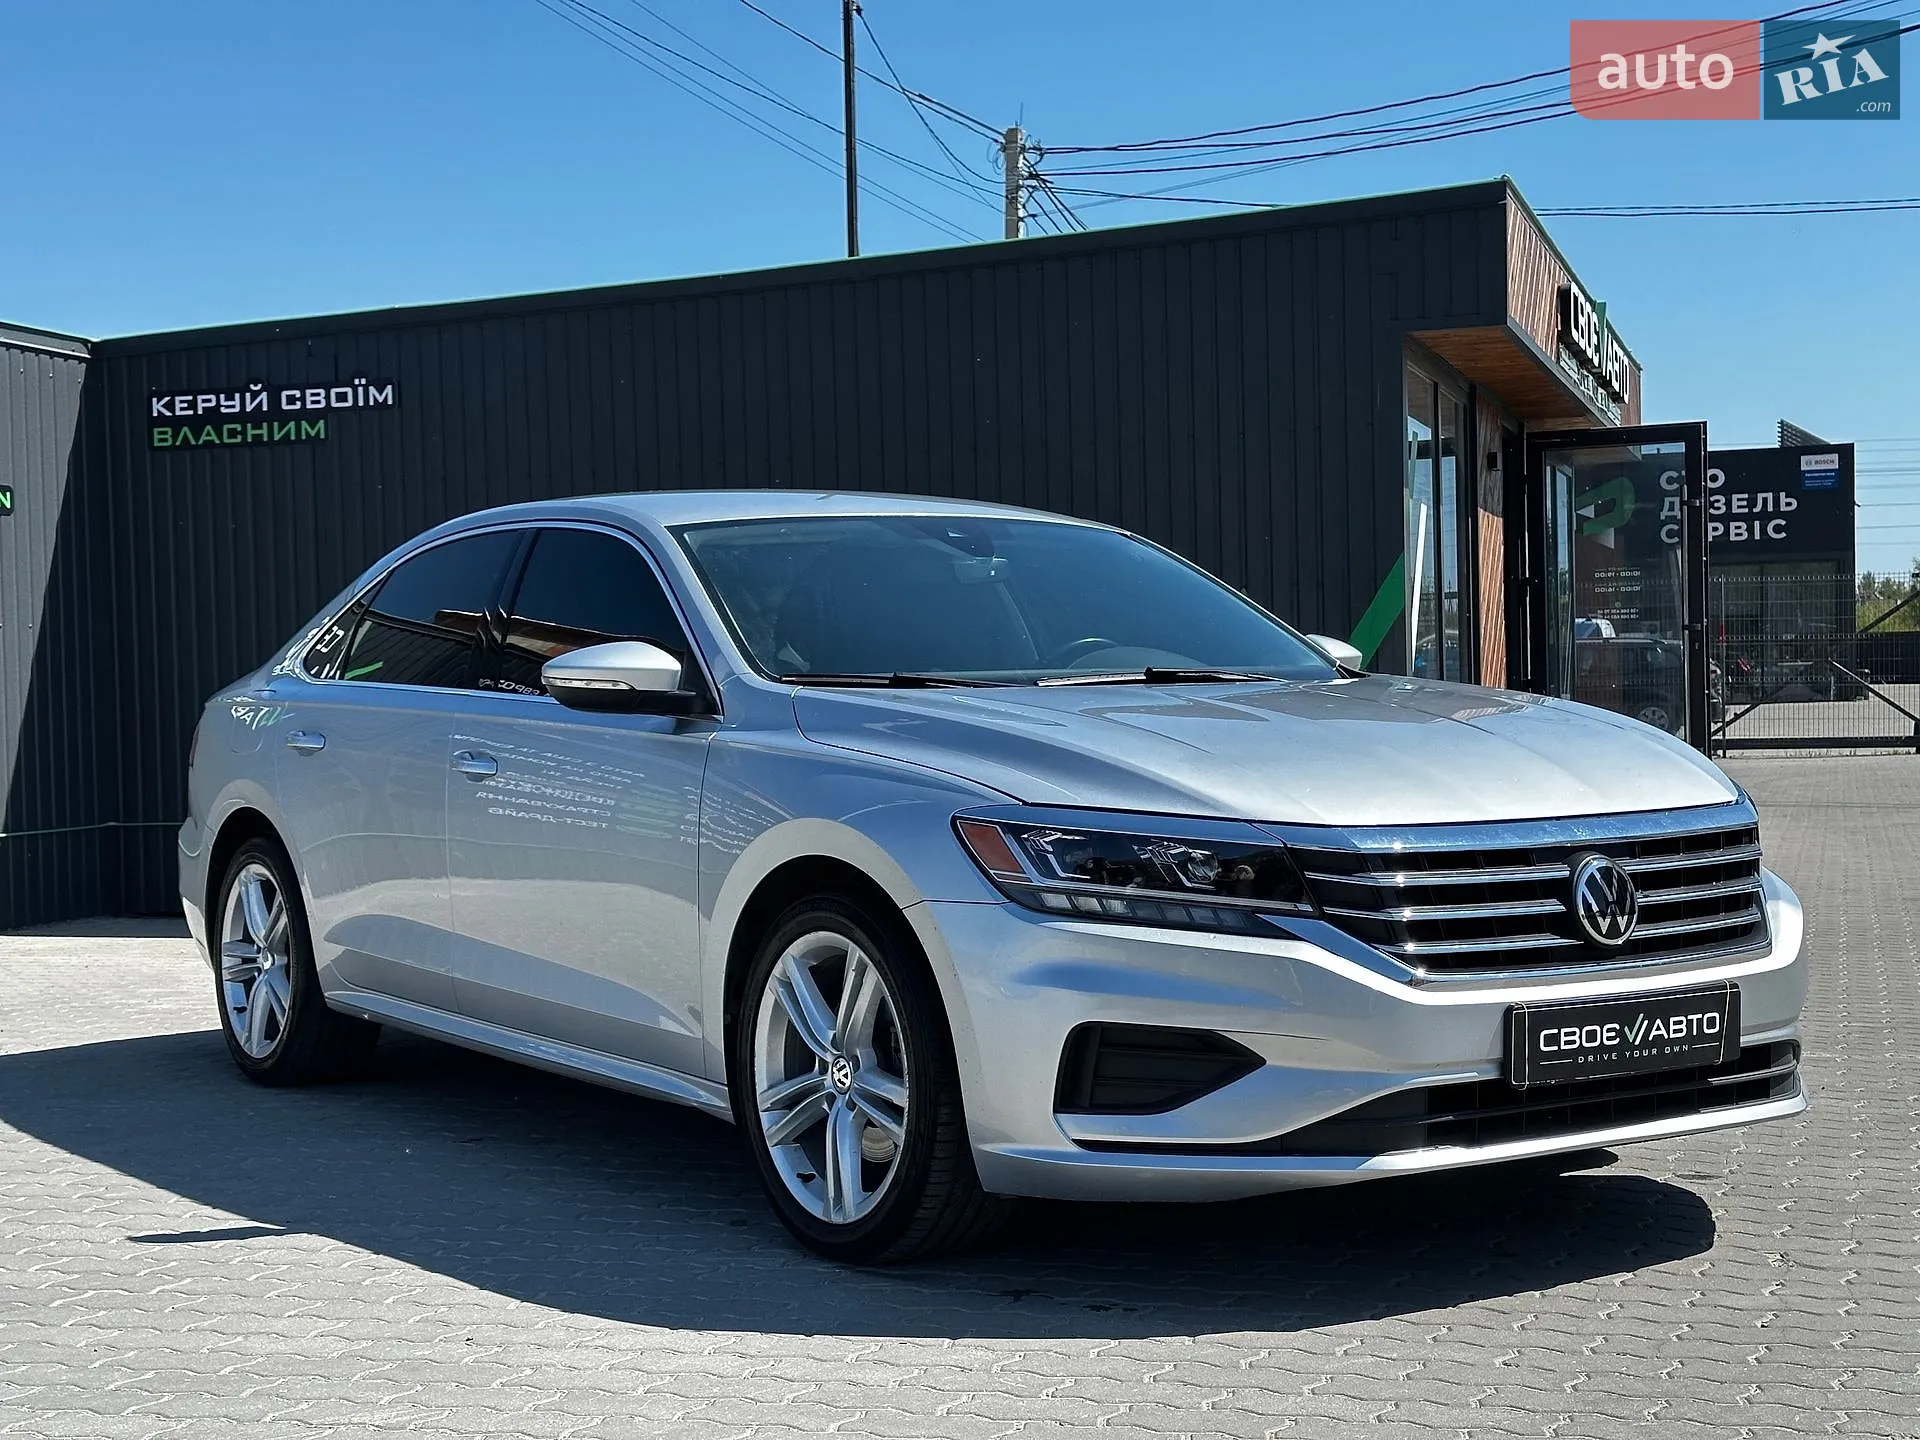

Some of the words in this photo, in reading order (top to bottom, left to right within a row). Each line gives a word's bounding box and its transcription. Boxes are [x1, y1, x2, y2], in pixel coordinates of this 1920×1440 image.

[152, 383, 268, 417] КЕРУЙ
[281, 378, 393, 411] СВОЇМ
[153, 419, 326, 447] ВЛАСНИМ
[1659, 468, 1725, 491] СО
[1660, 491, 1798, 520] ДЗЕЛЬ
[1660, 518, 1787, 544] СРВІС
[1577, 1052, 1618, 1064] DRIVE
[1624, 1047, 1658, 1058] YOUR
[1664, 1044, 1690, 1054] OWN
